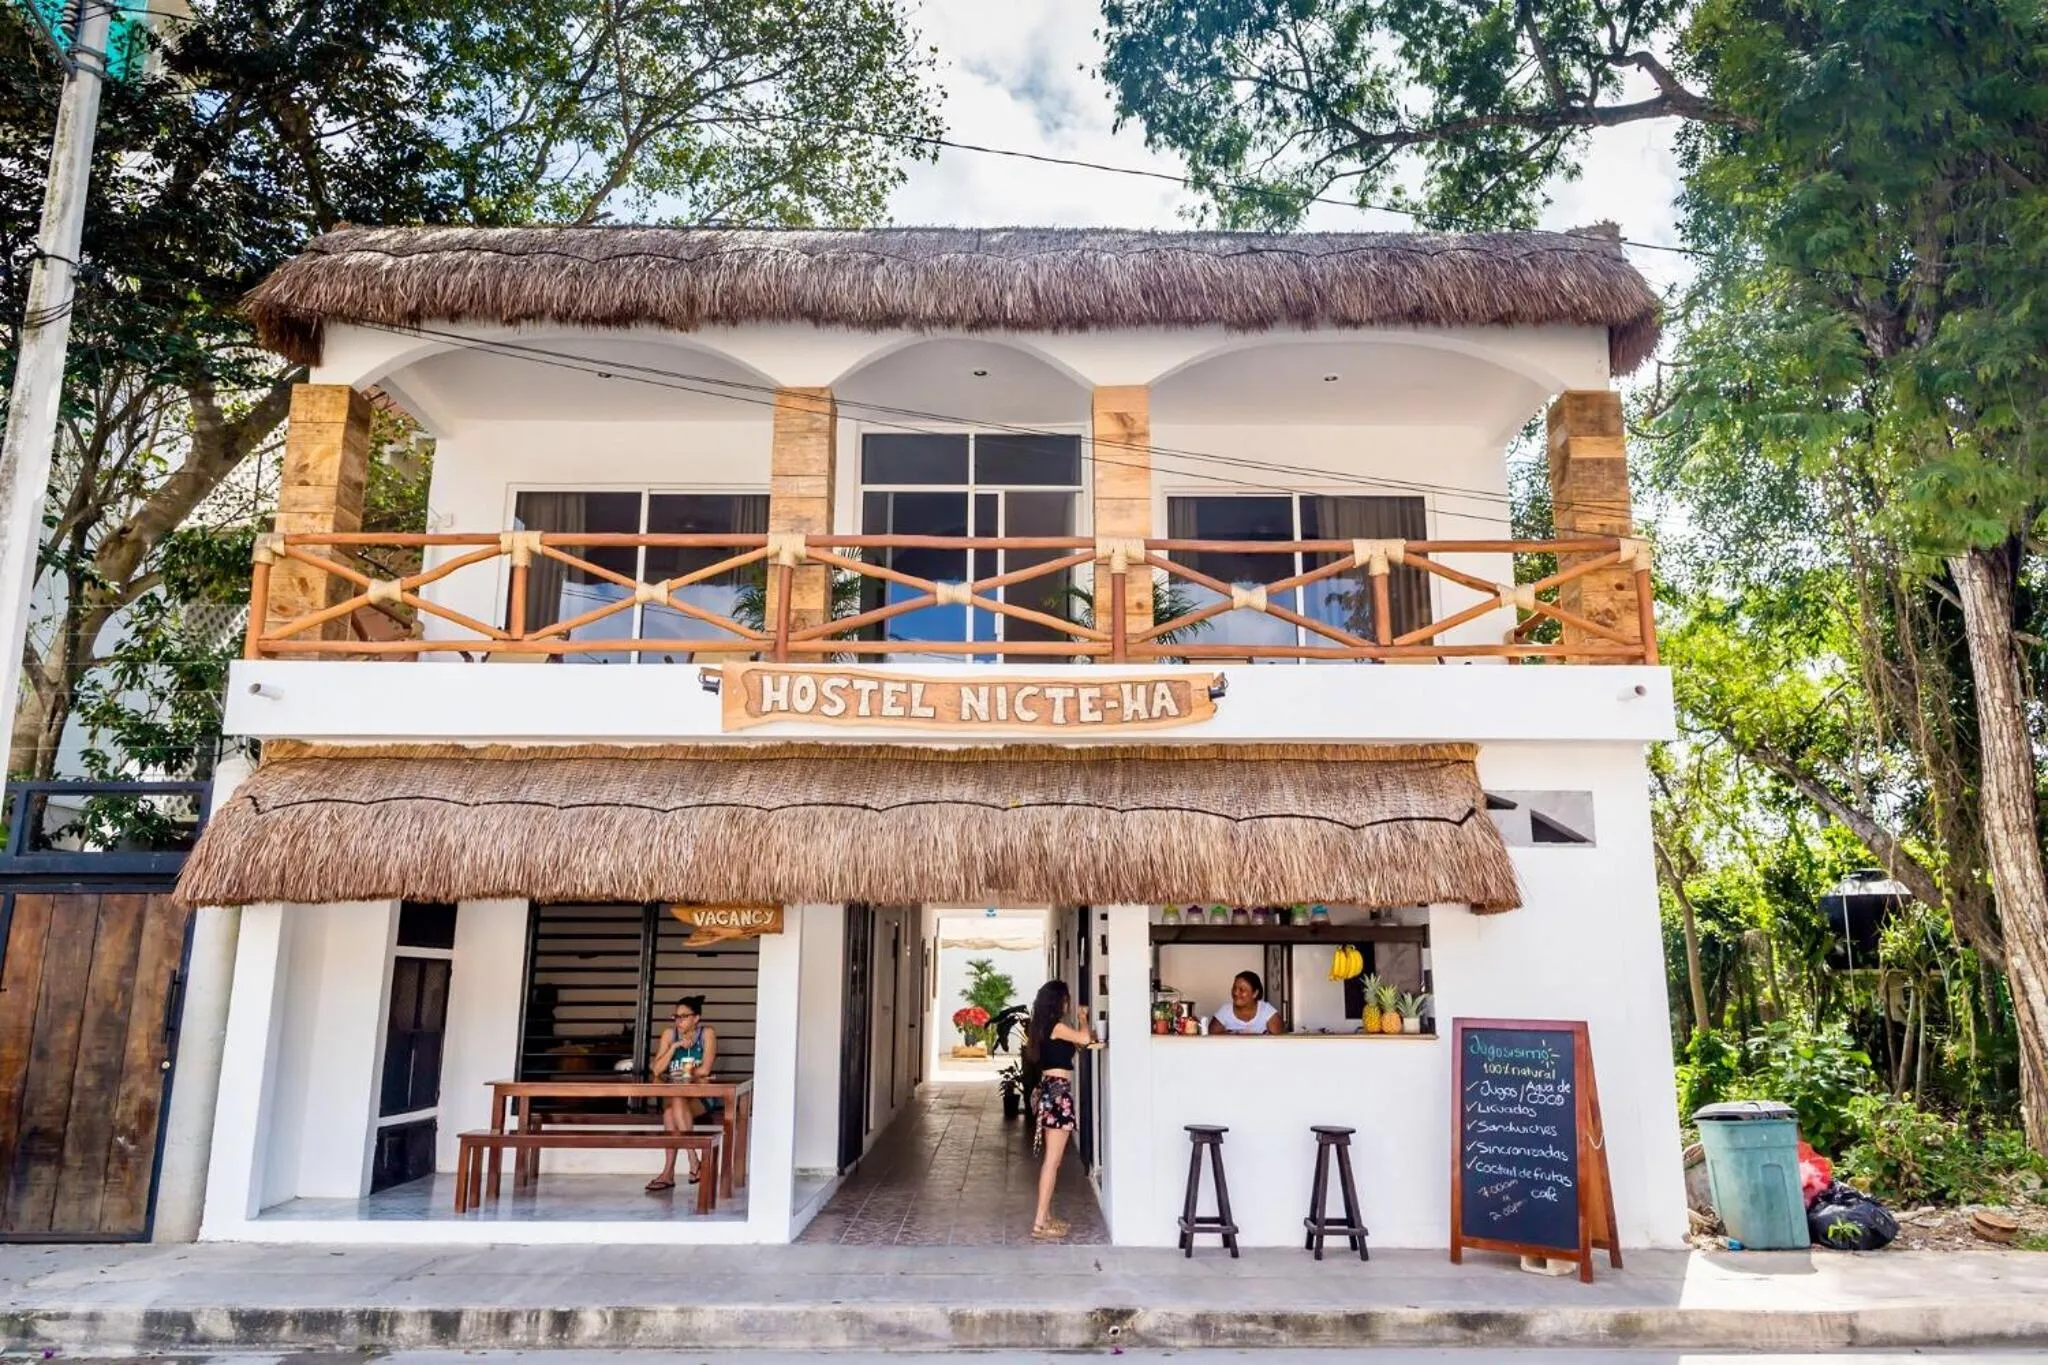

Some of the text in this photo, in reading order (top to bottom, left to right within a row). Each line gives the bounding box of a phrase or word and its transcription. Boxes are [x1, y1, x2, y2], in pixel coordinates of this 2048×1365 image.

[761, 675, 1179, 724] HOSTEL NICTE-HA
[693, 910, 774, 926] VACANCY
[1557, 1079, 1571, 1093] de
